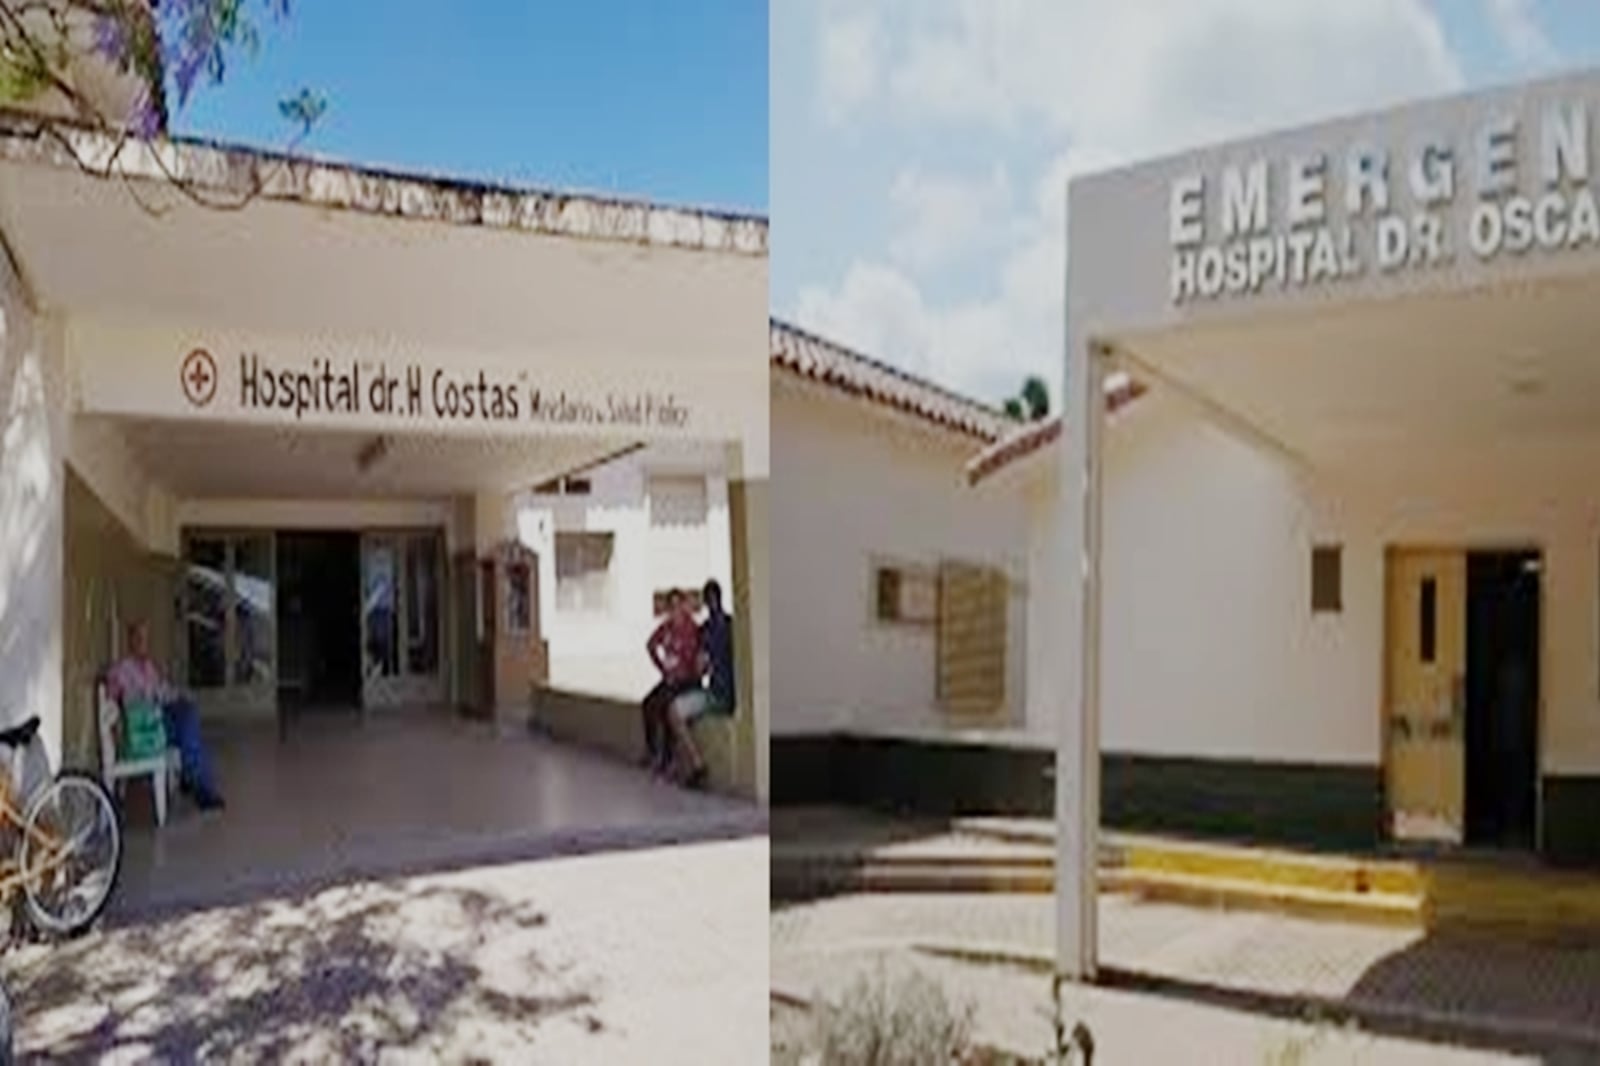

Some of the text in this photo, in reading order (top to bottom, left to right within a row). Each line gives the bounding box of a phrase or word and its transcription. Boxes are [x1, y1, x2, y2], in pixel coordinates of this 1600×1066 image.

[1169, 100, 1589, 243] EMERGEN
[1170, 225, 1361, 301] HOSPITAL
[1470, 188, 1600, 257] OSCA
[239, 352, 360, 419] Hospital
